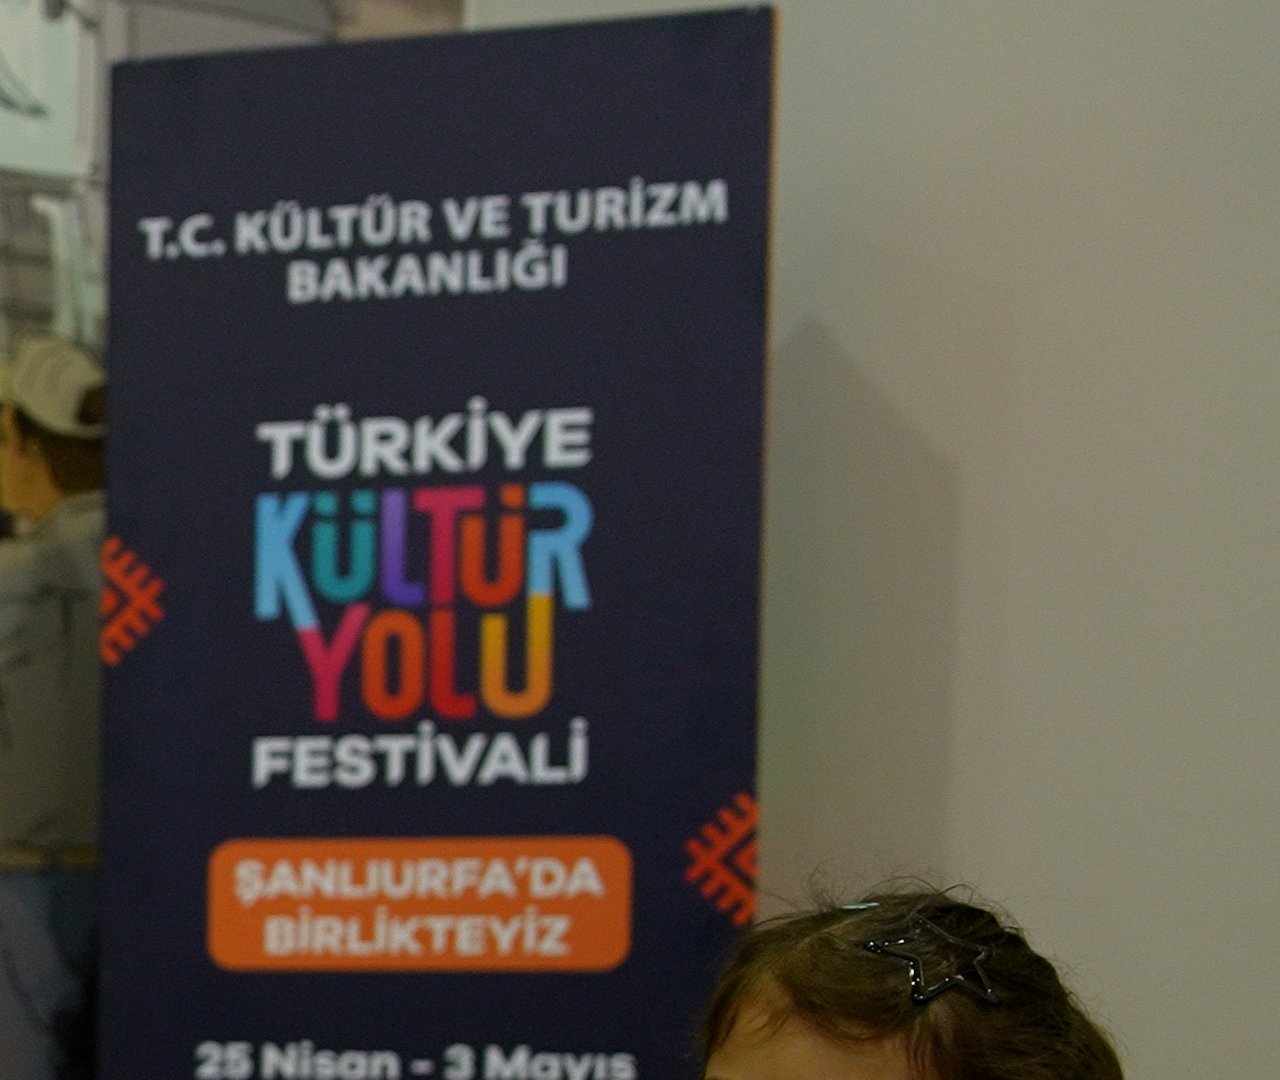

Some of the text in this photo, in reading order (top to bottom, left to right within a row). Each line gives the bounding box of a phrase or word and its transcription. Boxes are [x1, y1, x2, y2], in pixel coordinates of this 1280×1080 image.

[140, 176, 729, 260] T.C. KÜLTÜR VE TURİZM
[287, 240, 568, 303] BAKANLIĞI
[257, 396, 594, 480] TÜRKİYE
[253, 481, 595, 629] KÜLTÜR
[297, 593, 554, 722] YOLU
[250, 716, 590, 789] FESTİVALİ
[235, 857, 604, 906] ŞANLIURFA'DA
[264, 907, 572, 959] BİRLİKTEYİZ
